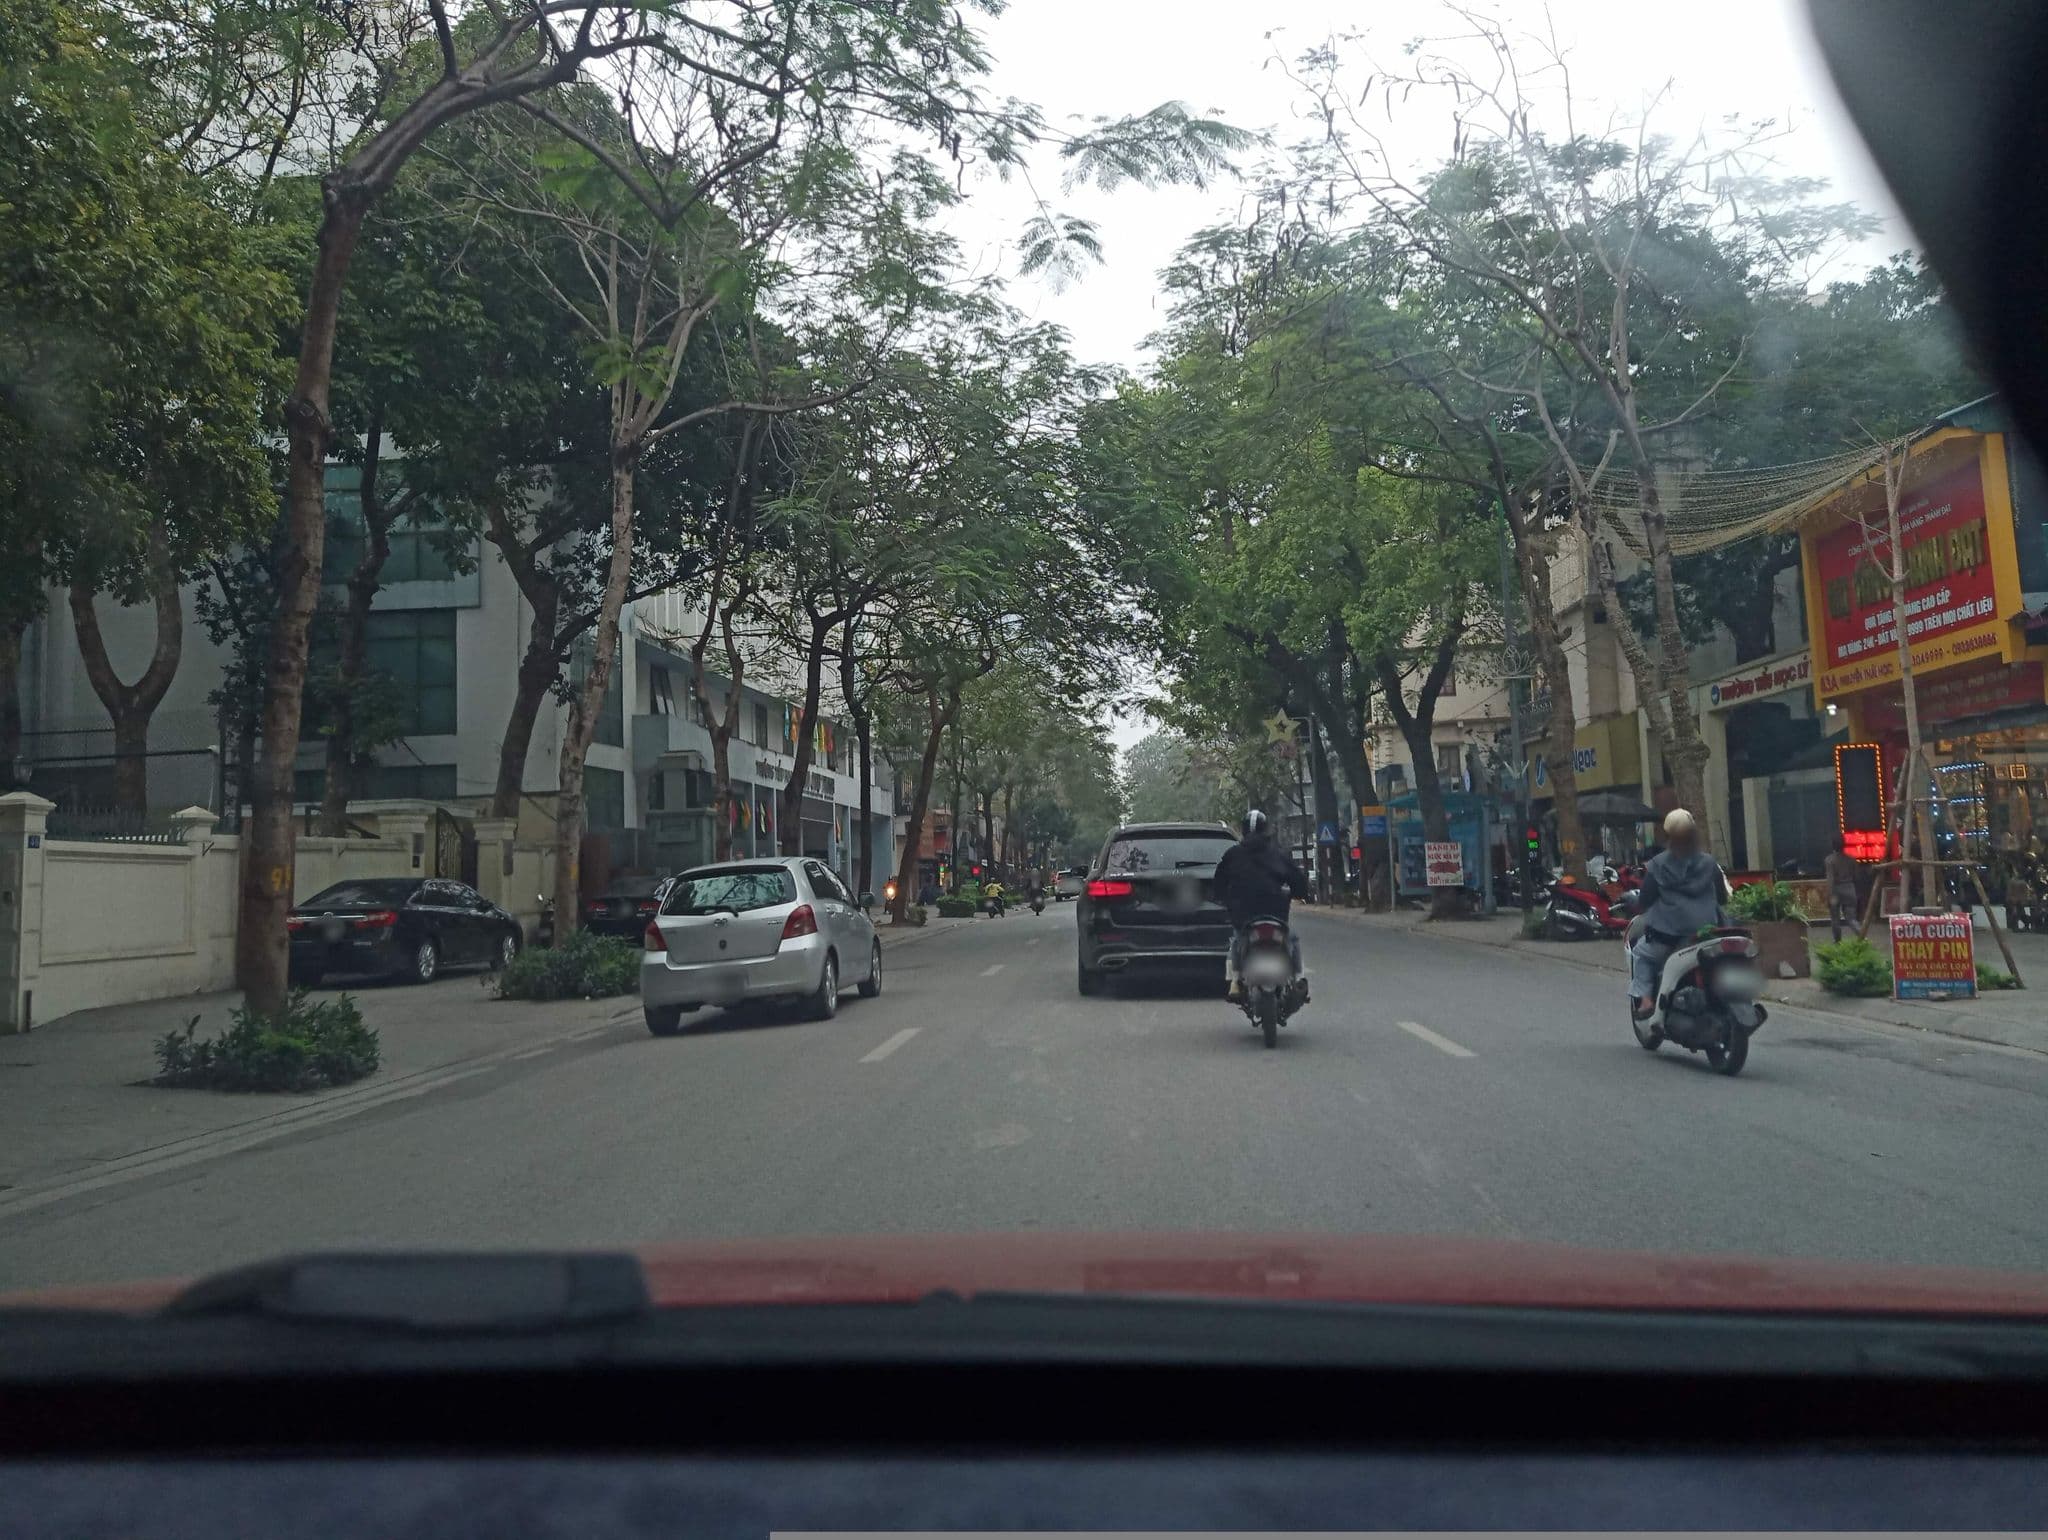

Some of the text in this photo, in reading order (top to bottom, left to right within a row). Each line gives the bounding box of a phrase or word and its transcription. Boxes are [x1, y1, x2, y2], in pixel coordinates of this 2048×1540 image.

[1921, 594, 1936, 611] CAO
[1956, 598, 1976, 621] CHẤT
[1976, 595, 1994, 618] LIỆU
[1897, 940, 1970, 961] THAY PIN
